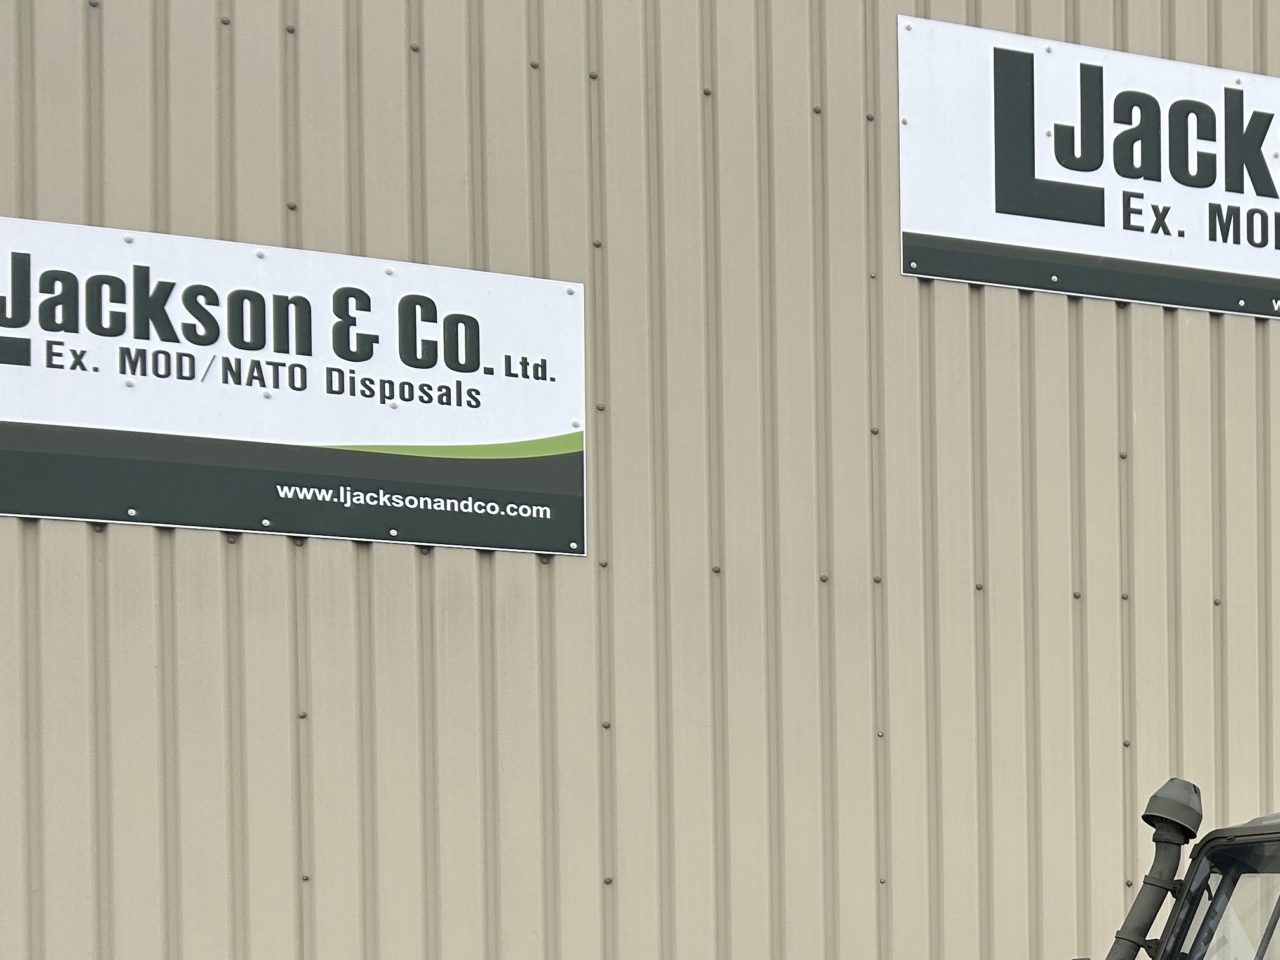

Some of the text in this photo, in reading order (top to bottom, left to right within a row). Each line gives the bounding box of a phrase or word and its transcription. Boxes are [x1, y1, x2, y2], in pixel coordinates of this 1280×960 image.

[1122, 190, 1185, 238] Ex.
[332, 286, 380, 363] &
[398, 294, 495, 376] Co.
[504, 354, 556, 382] Ltd.
[45, 339, 99, 373] Ex.
[119, 346, 308, 392] MOD/NATO
[325, 366, 481, 409] Disposals
[276, 485, 551, 519] www.ljacksonandco.com
